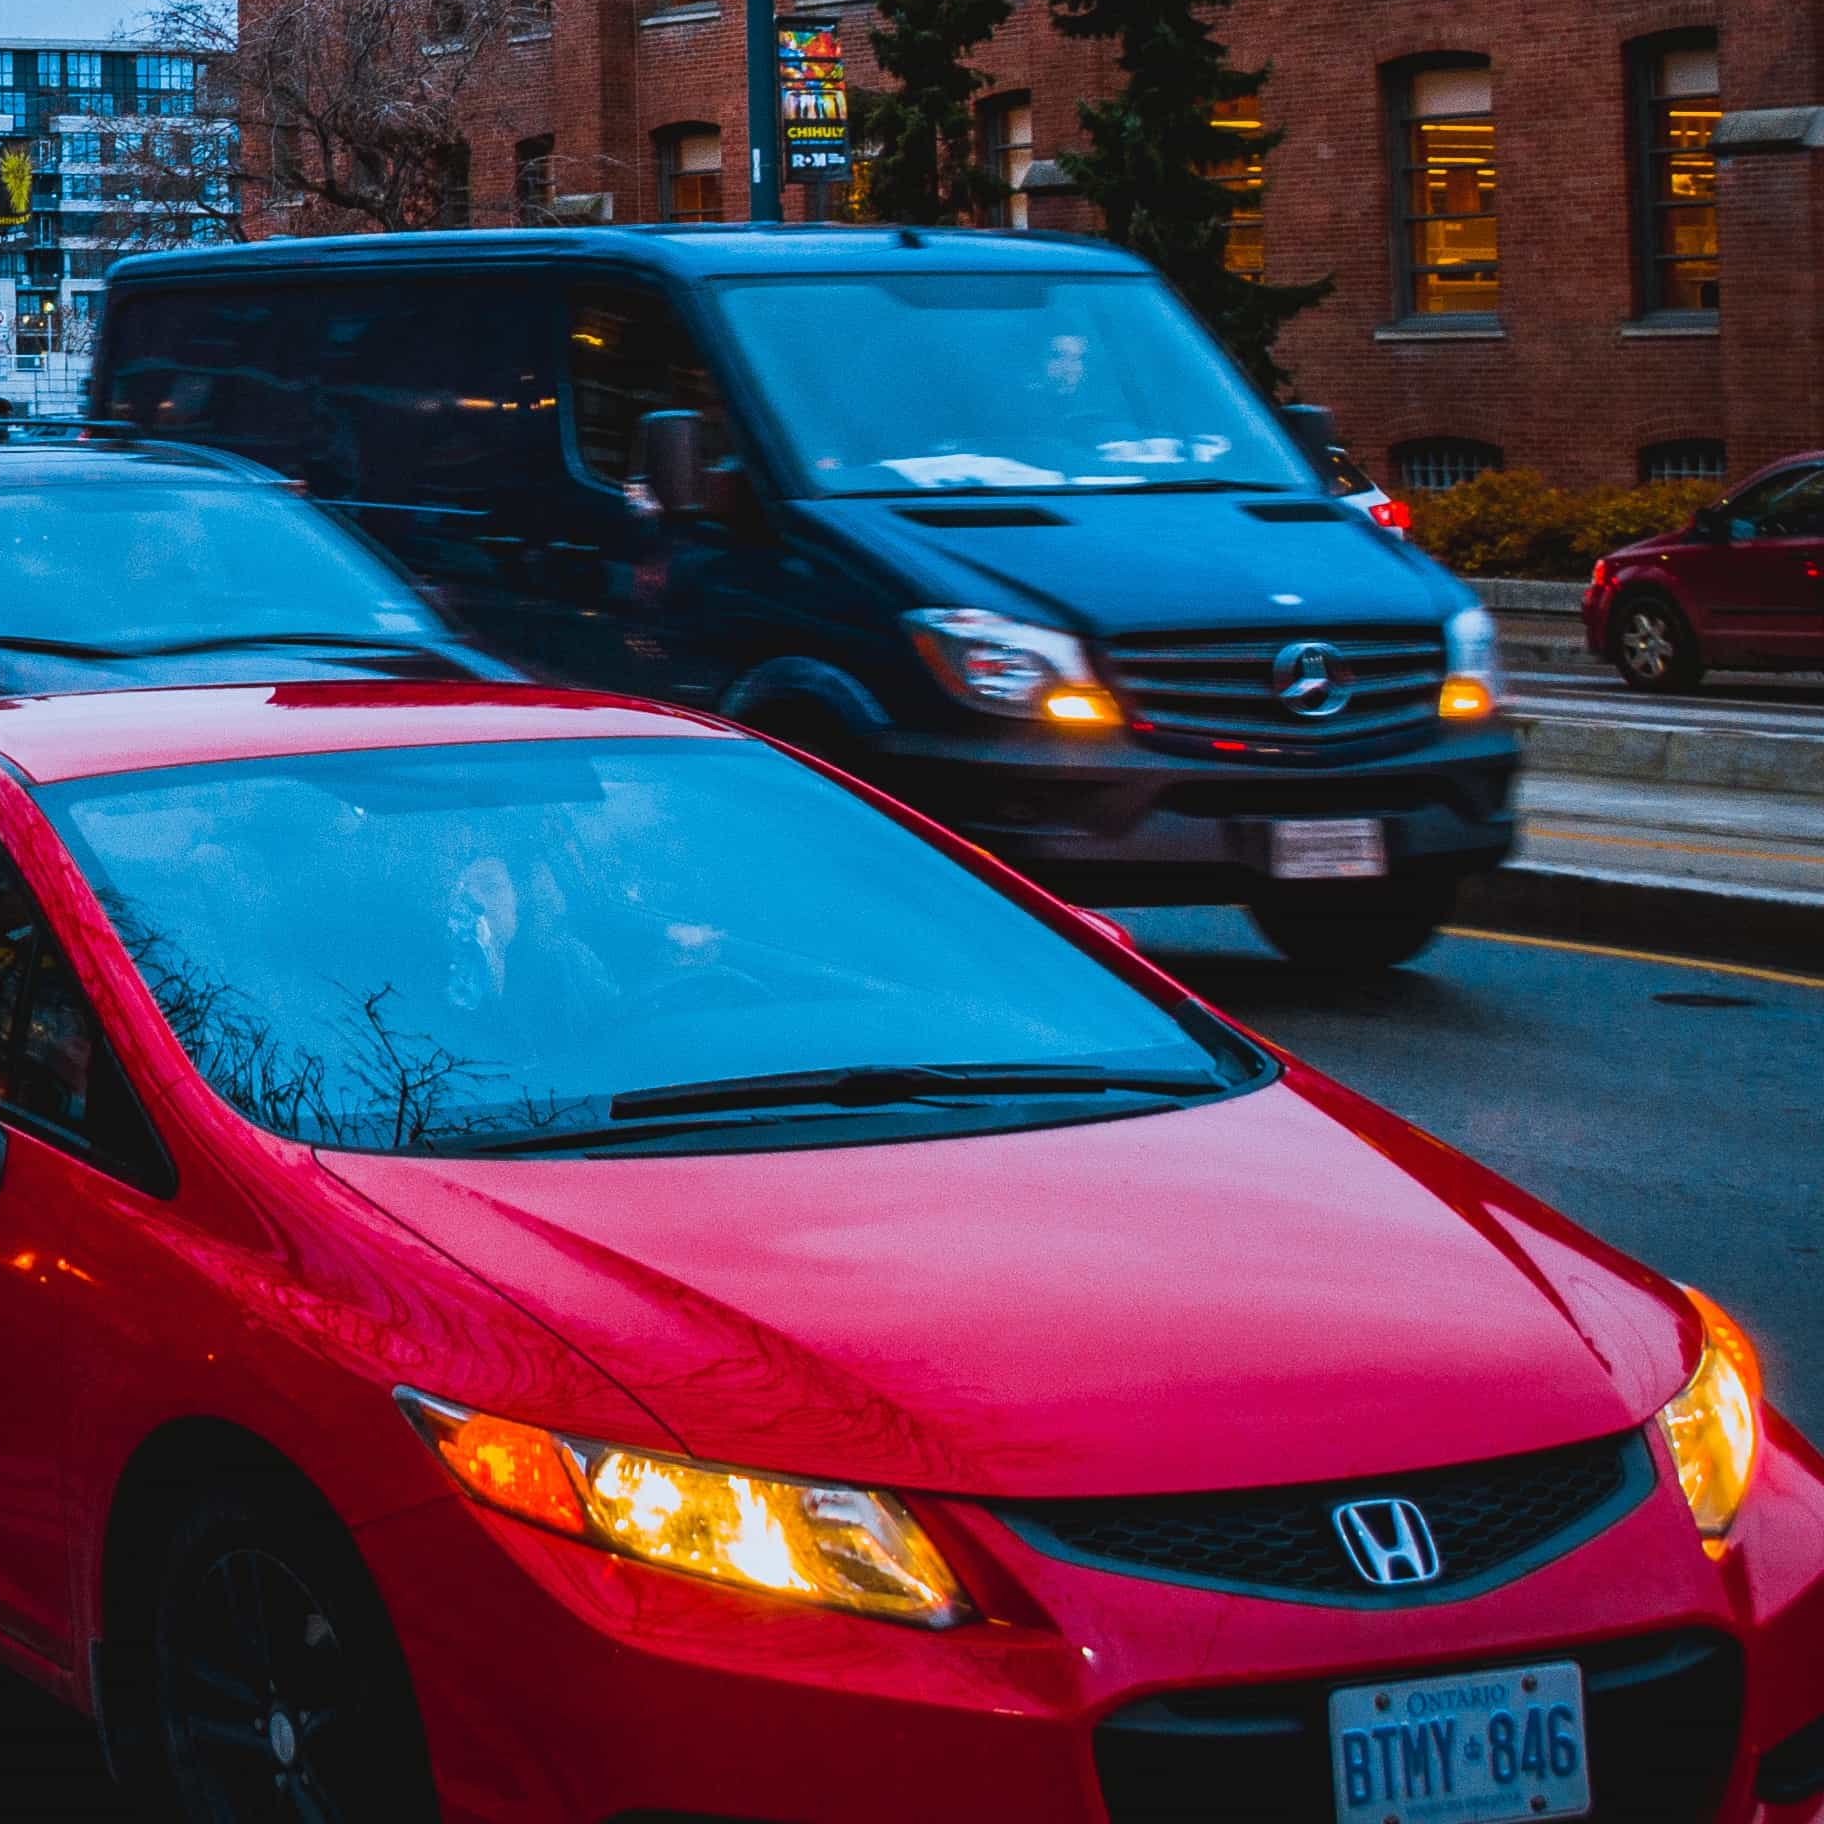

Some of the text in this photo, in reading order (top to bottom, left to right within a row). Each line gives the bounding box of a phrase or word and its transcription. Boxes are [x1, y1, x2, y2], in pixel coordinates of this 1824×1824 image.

[787, 126, 846, 139] CHIHULY
[1342, 1703, 1578, 1806] BTMY 846
